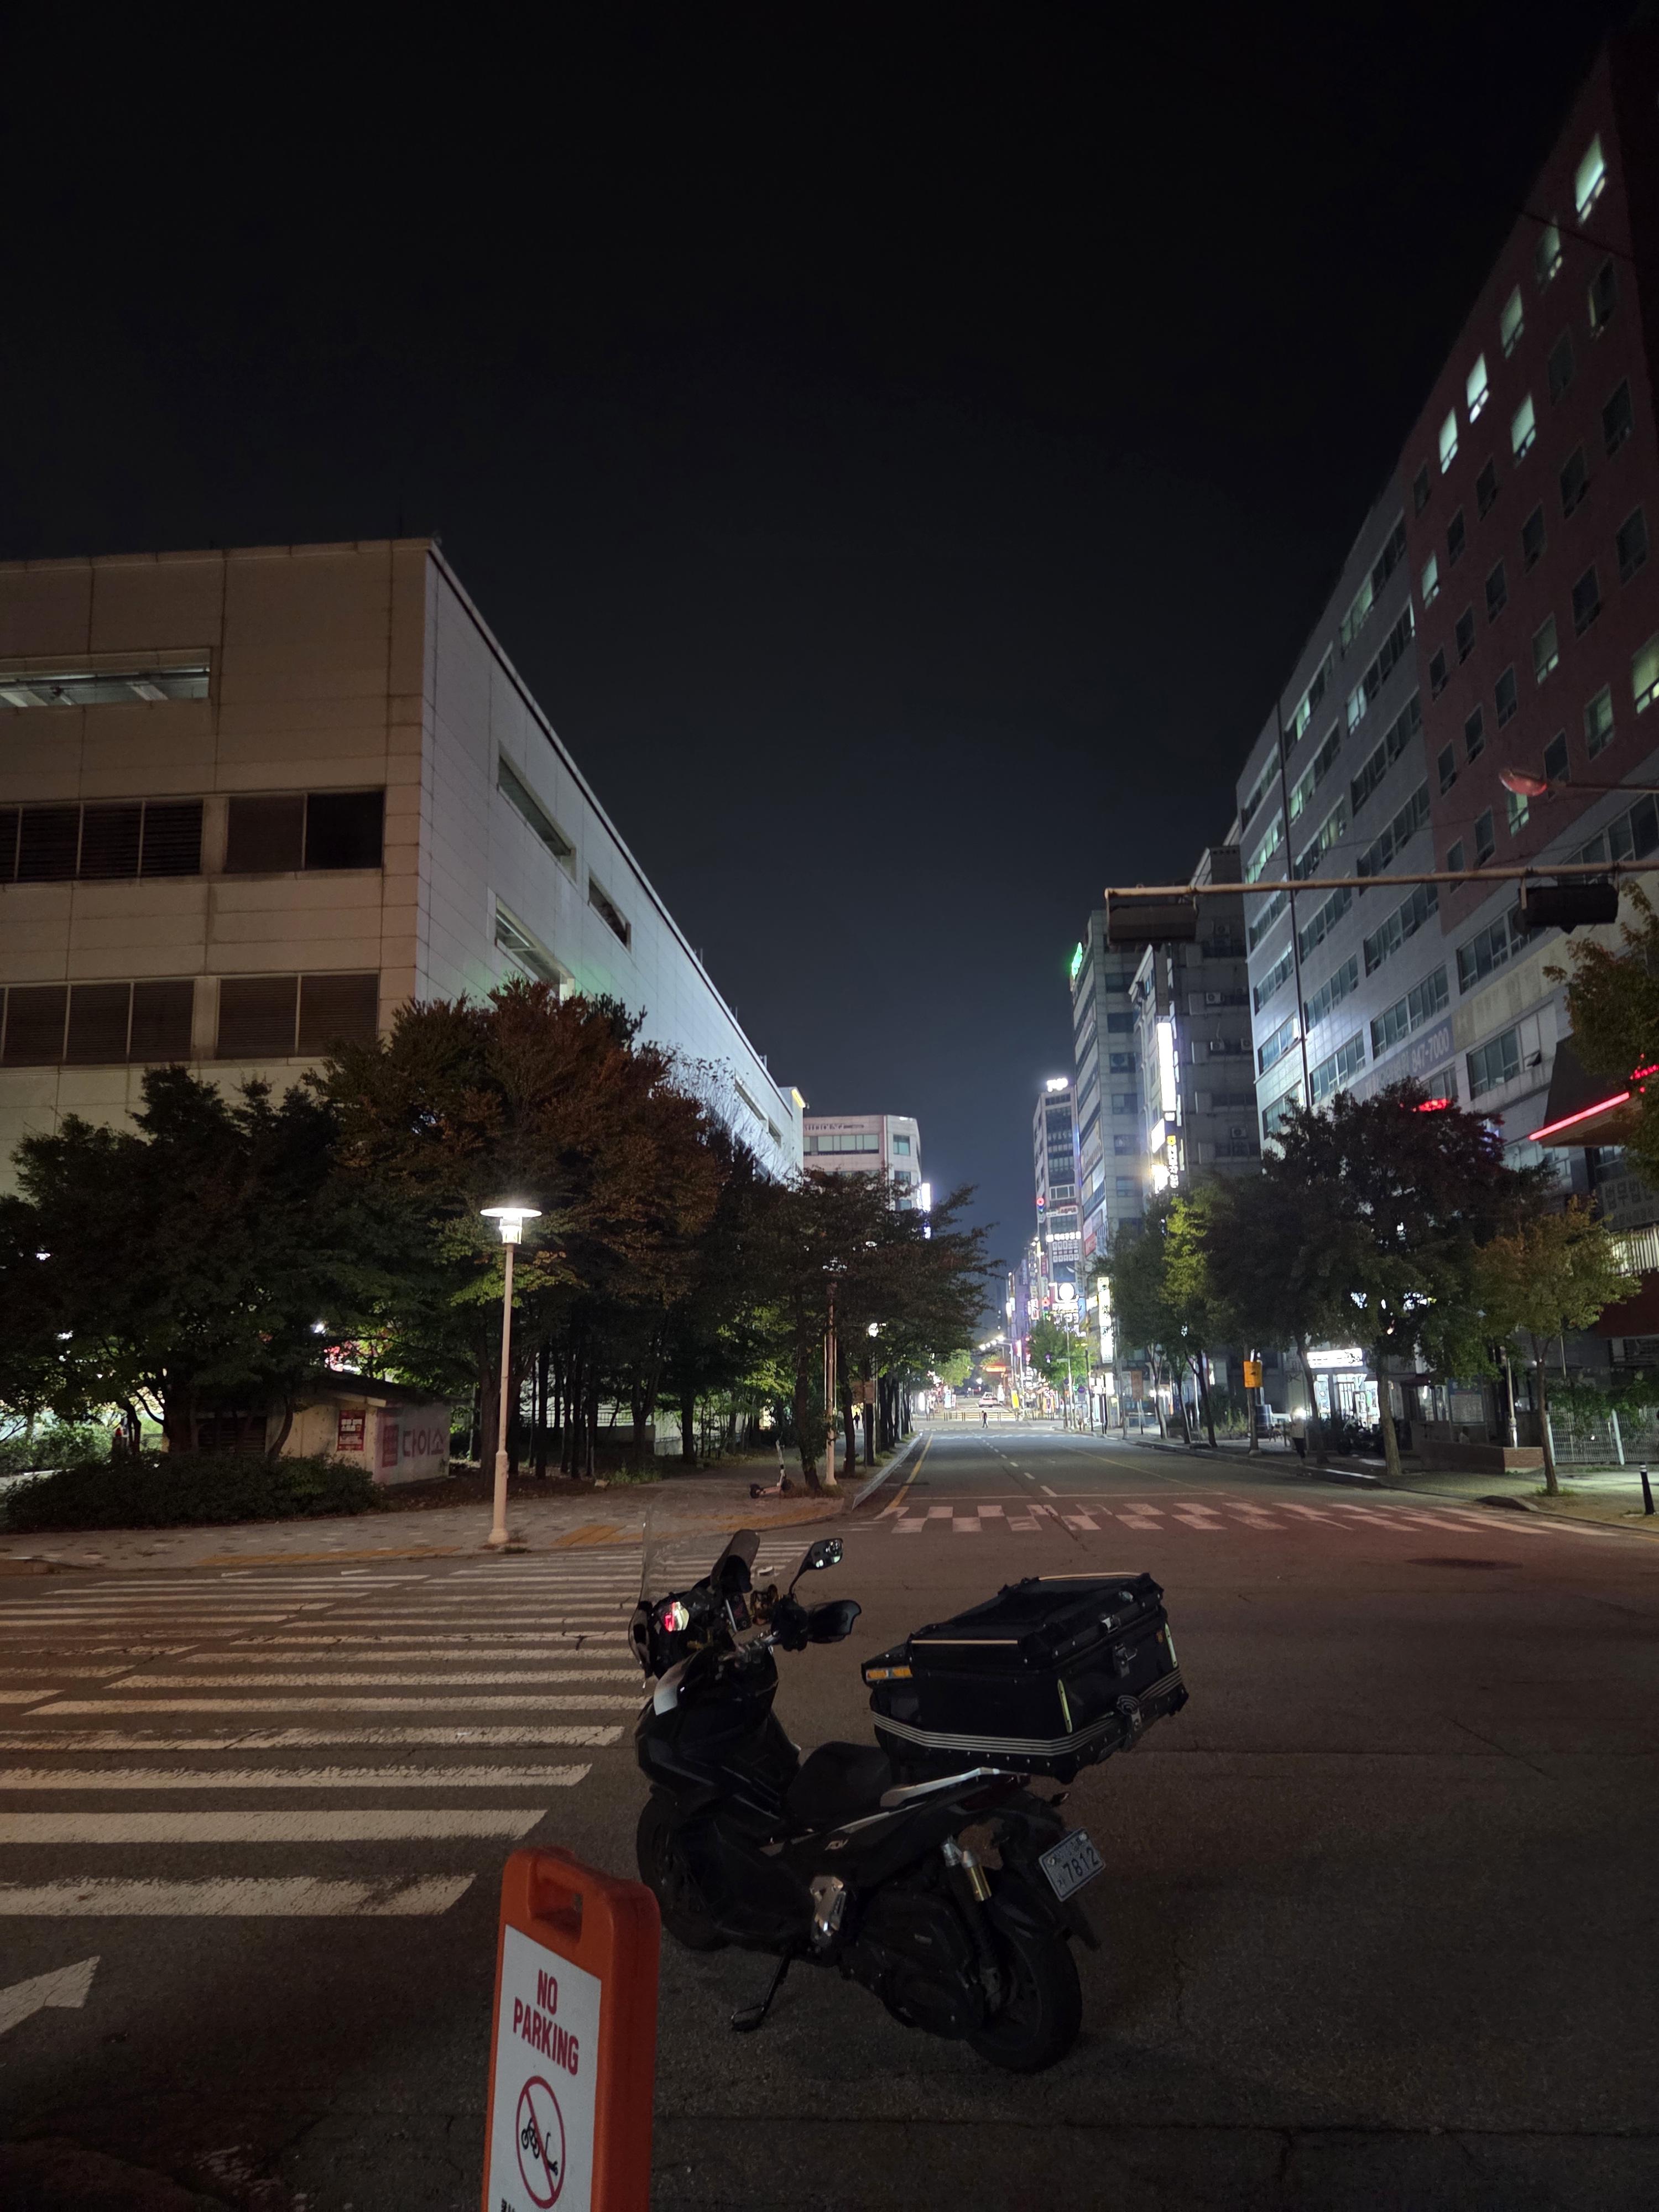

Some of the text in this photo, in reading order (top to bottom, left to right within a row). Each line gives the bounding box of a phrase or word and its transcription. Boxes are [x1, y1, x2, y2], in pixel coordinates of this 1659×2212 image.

[403, 1427, 444, 1458] 다이소
[1062, 1846, 1099, 1883] 7812
[537, 1969, 558, 2015] NO
[513, 1996, 579, 2076] PARKING
